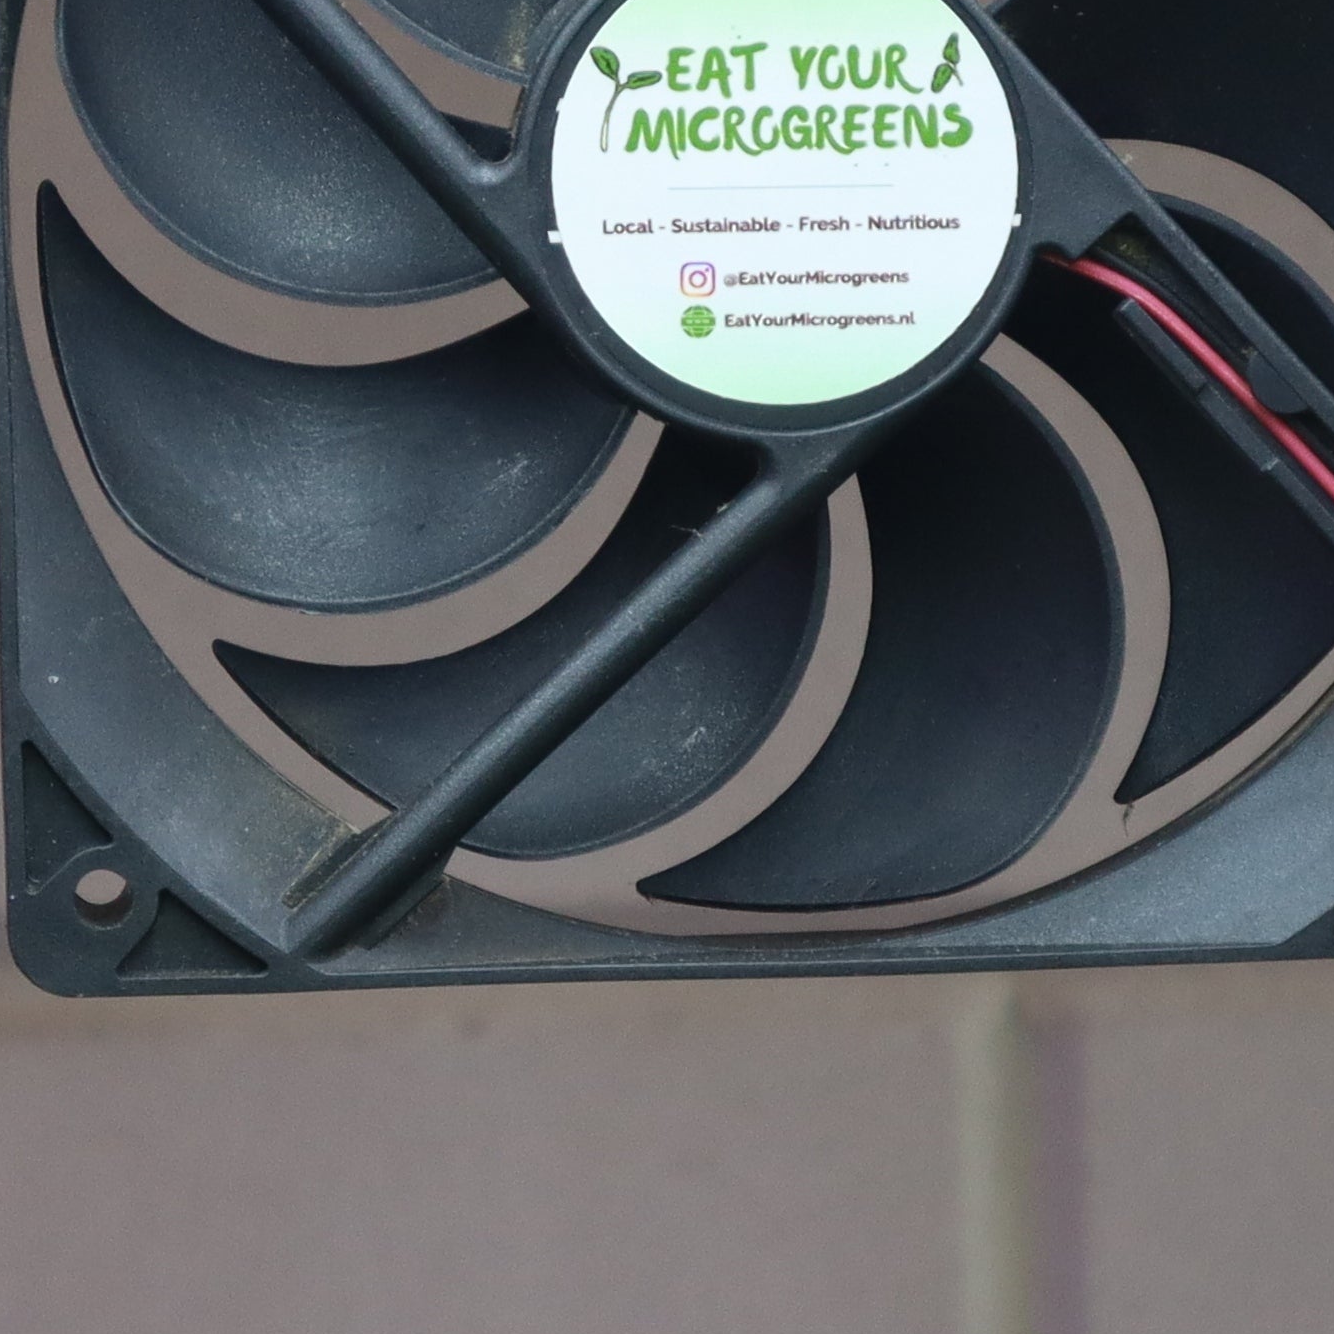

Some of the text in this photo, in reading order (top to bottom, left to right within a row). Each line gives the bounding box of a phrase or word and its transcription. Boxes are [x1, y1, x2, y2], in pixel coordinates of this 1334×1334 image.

[665, 41, 923, 98] EAT YOUR
[624, 104, 973, 160] MICROGREENS
[602, 218, 653, 234] Local
[671, 216, 780, 233] Sustainable
[799, 216, 849, 232] Fresh
[867, 214, 960, 231] Nutritious
[723, 270, 909, 288] @EatYourMicrogreens
[724, 311, 915, 329] EatYourMicrogreens.nl
